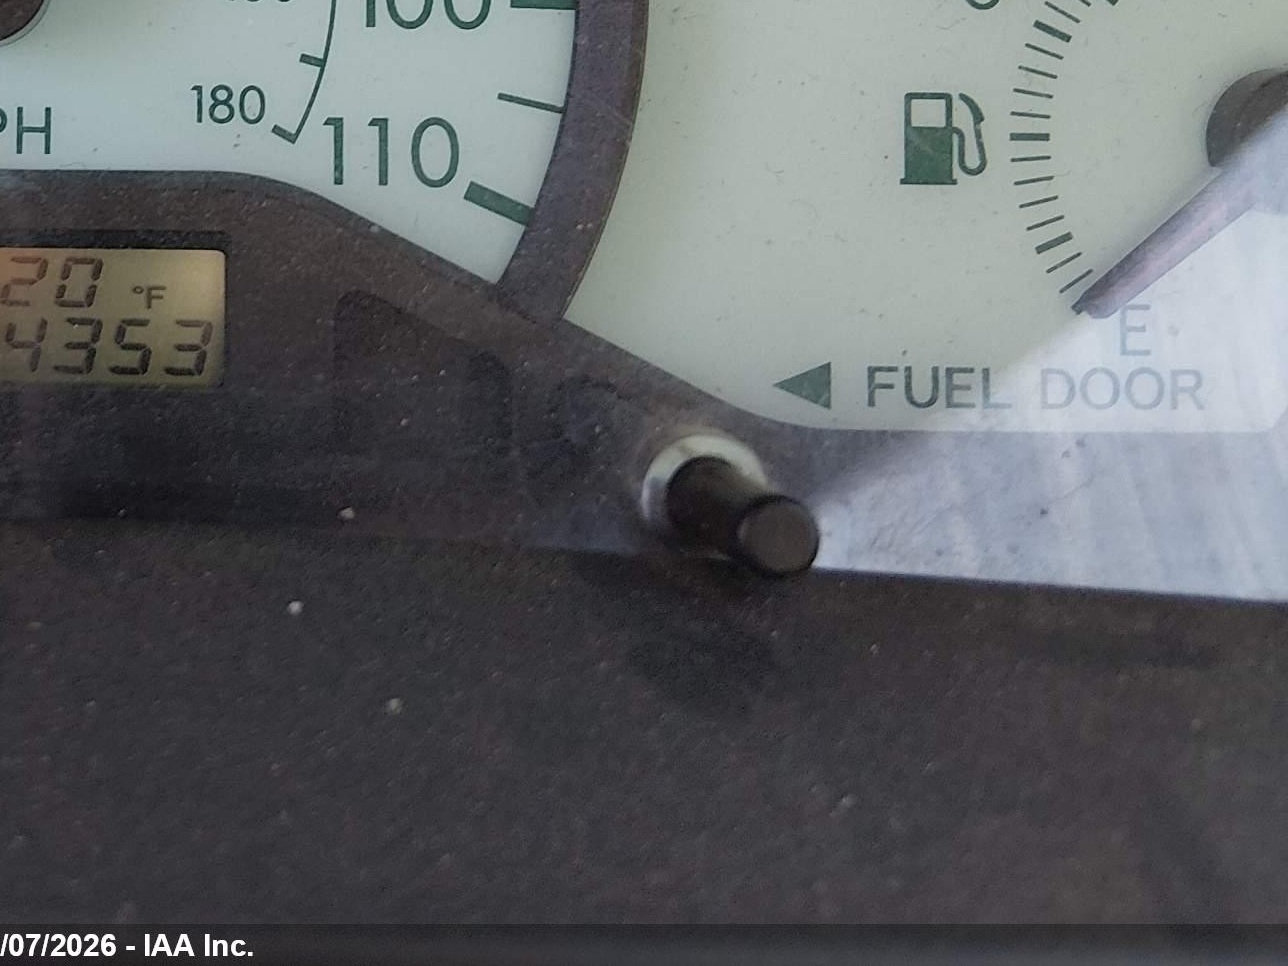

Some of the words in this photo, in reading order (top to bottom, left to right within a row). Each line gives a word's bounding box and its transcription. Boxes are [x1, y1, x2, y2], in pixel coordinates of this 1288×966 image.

[190, 85, 266, 125] 180
[322, 117, 459, 188] 110
[1119, 303, 1151, 357] E
[867, 365, 1012, 409] FUEL
[1040, 367, 1205, 410] DOOR
